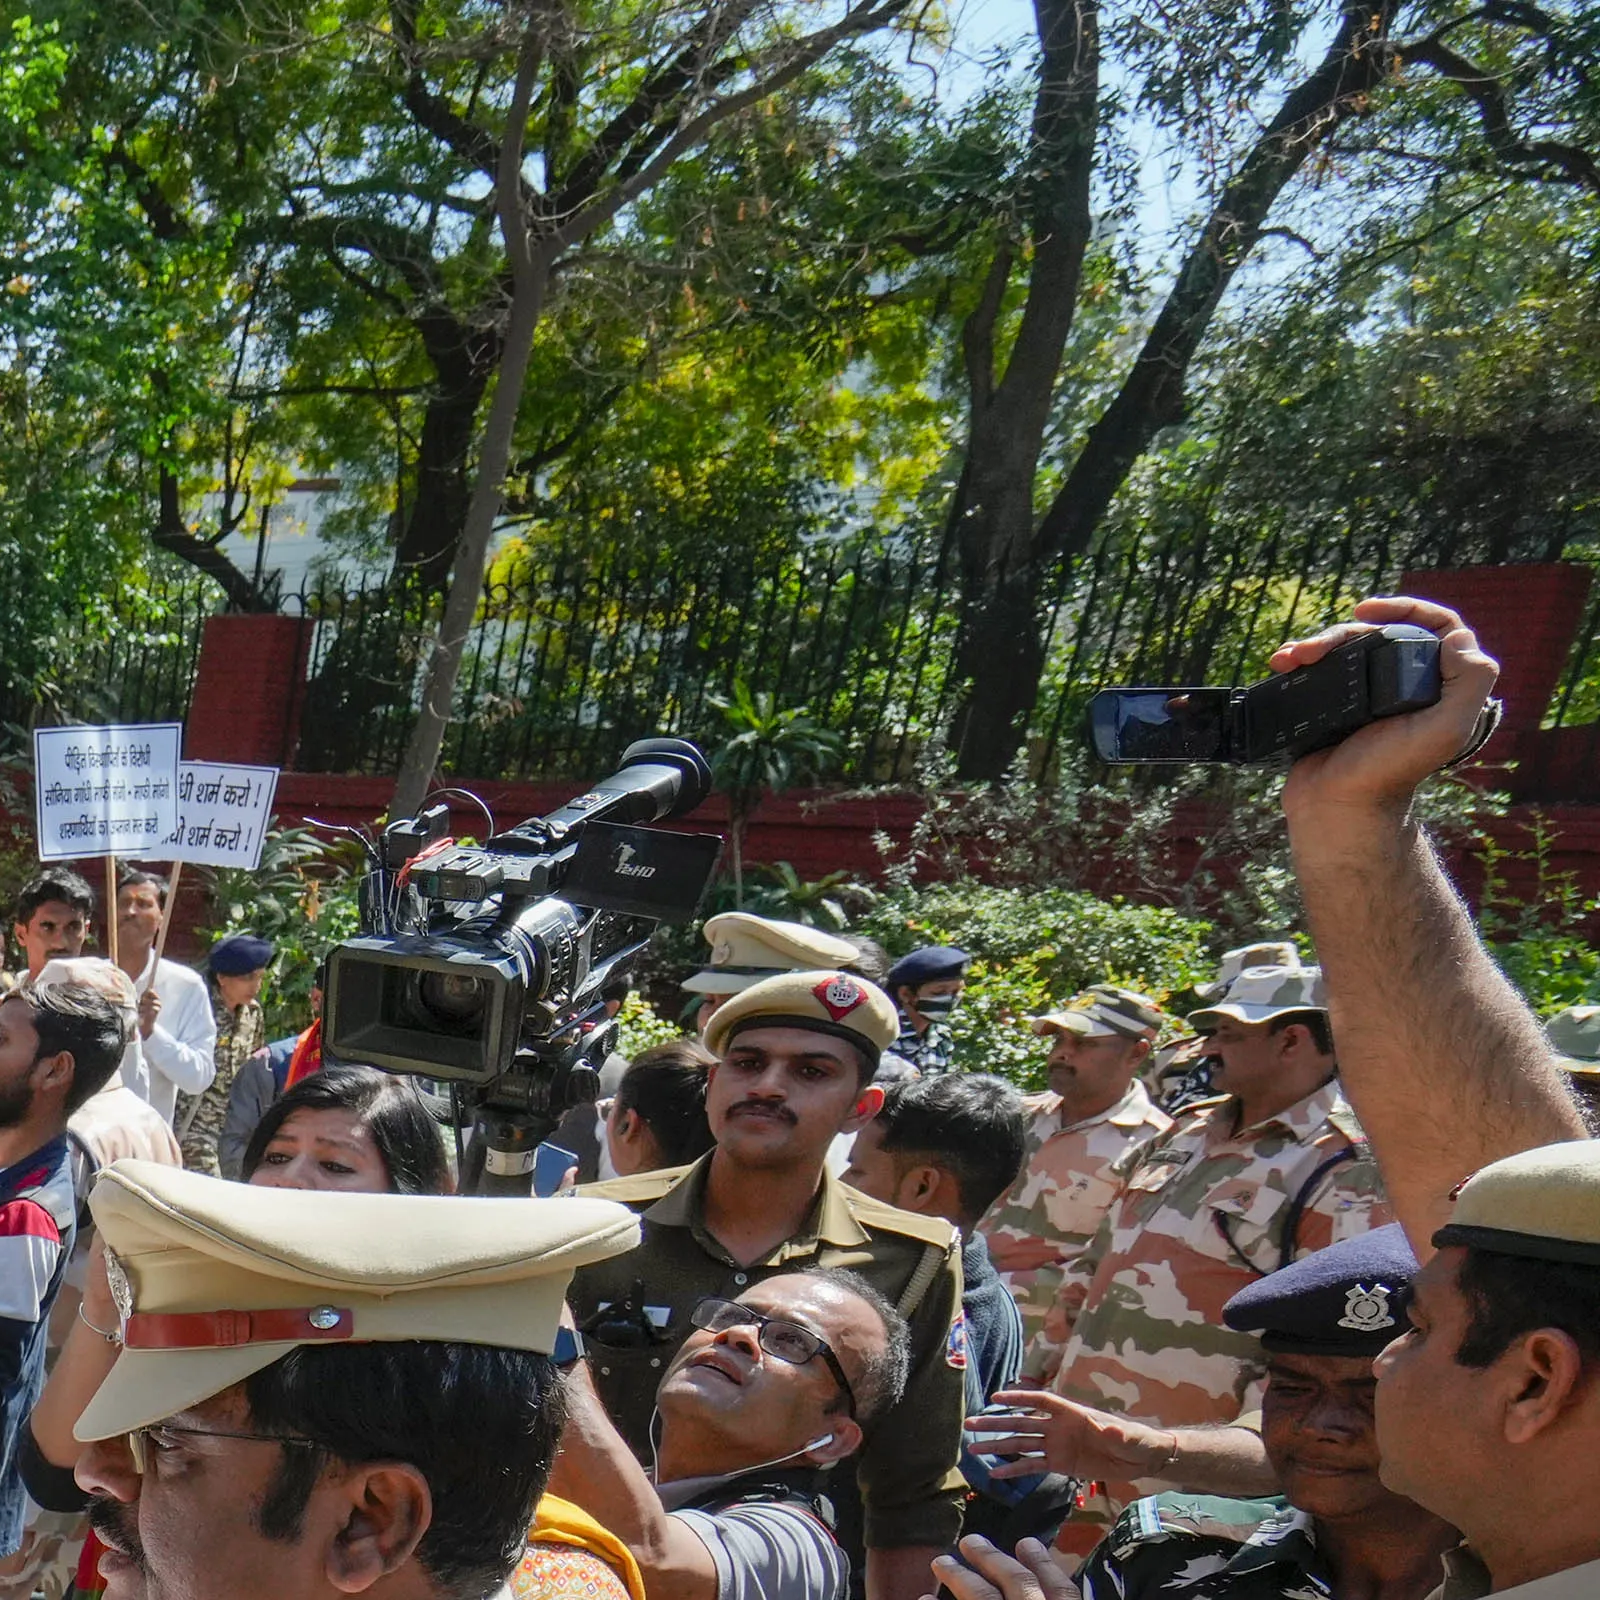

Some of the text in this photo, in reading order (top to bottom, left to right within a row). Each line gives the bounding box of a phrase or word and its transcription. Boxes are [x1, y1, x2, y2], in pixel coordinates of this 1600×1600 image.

[45, 781, 72, 806] सोनिया
[74, 779, 92, 803] गांधी
[196, 774, 224, 804] शर्म
[223, 778, 252, 808] करो
[188, 818, 214, 848] शर्म
[213, 822, 242, 851] करो
